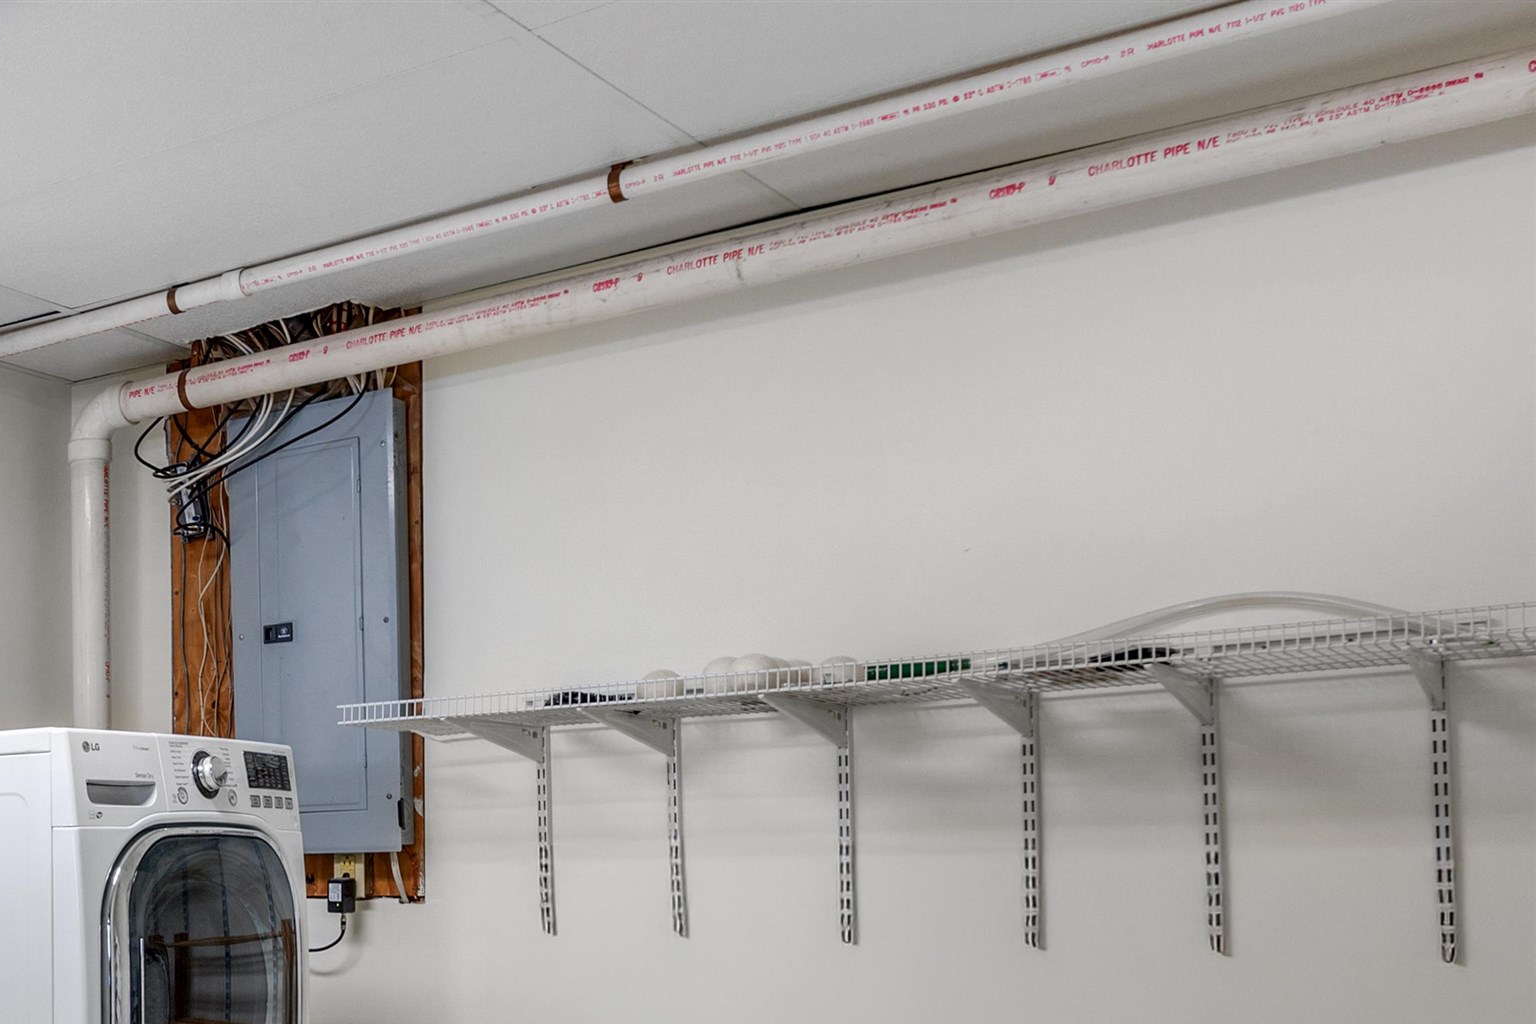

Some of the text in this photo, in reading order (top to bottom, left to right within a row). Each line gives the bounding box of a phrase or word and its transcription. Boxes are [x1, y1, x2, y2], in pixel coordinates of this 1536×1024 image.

[1087, 135, 1220, 176] CHARLOTTE PIPE N/E
[666, 243, 764, 275] CHARLOTTE PIPE N/E
[345, 331, 386, 349] CHARLOTTE
[389, 327, 406, 339] PIPE
[408, 323, 422, 335] N/E
[128, 388, 142, 399] PIPE
